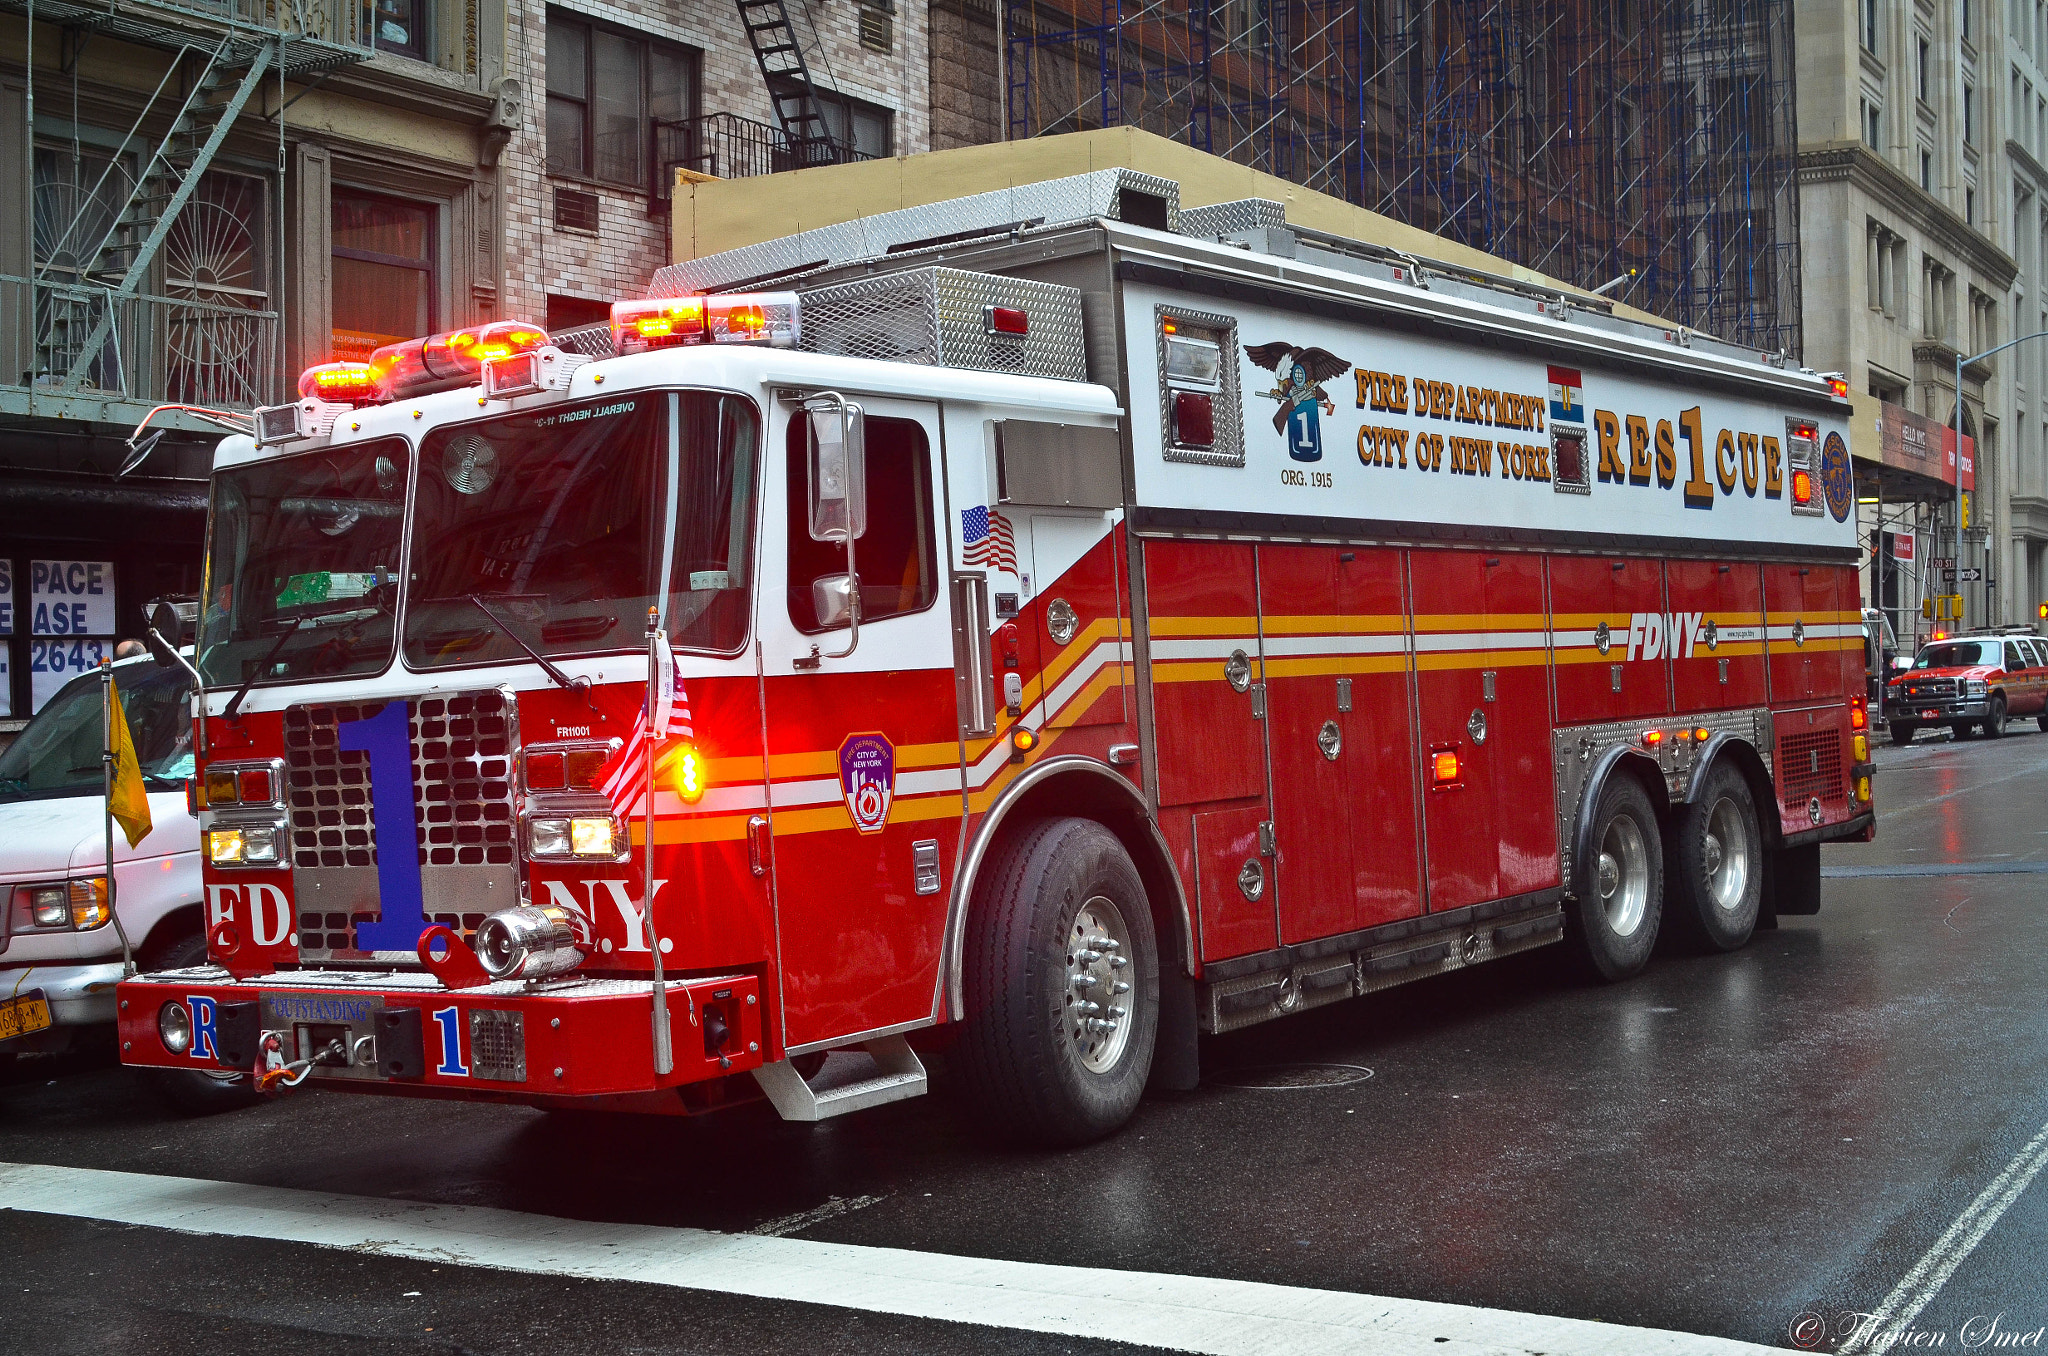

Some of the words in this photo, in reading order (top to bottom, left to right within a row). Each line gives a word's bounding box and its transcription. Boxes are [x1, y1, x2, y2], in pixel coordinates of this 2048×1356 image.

[355, 337, 378, 346] SPIRITED
[338, 350, 360, 360] FESTIVE
[1354, 367, 1410, 416] FIRE
[1413, 376, 1546, 434] DEPARTMENT
[1295, 411, 1314, 448] 1
[1356, 424, 1410, 469] CITY
[1415, 431, 1444, 472] OF
[1448, 435, 1494, 478] NEW
[1497, 440, 1552, 483] YORK
[1824, 435, 1848, 461] RESCUE
[1280, 469, 1308, 487] ORG.
[1310, 471, 1333, 488] 1915
[1934, 559, 1943, 568] 20
[1945, 559, 1953, 568] ST
[1626, 612, 1703, 662] FDNY
[31, 639, 103, 673] 2643
[556, 725, 590, 738] FR11001
[844, 746, 856, 764] FIRE
[854, 739, 890, 760] DEPARTMENT
[853, 761, 866, 769] NEW
[866, 759, 882, 767] YORK
[856, 751, 869, 759] CITY
[869, 750, 878, 758] OF
[338, 700, 451, 952] 1
[186, 994, 220, 1060] R
[433, 1005, 469, 1077] 1
